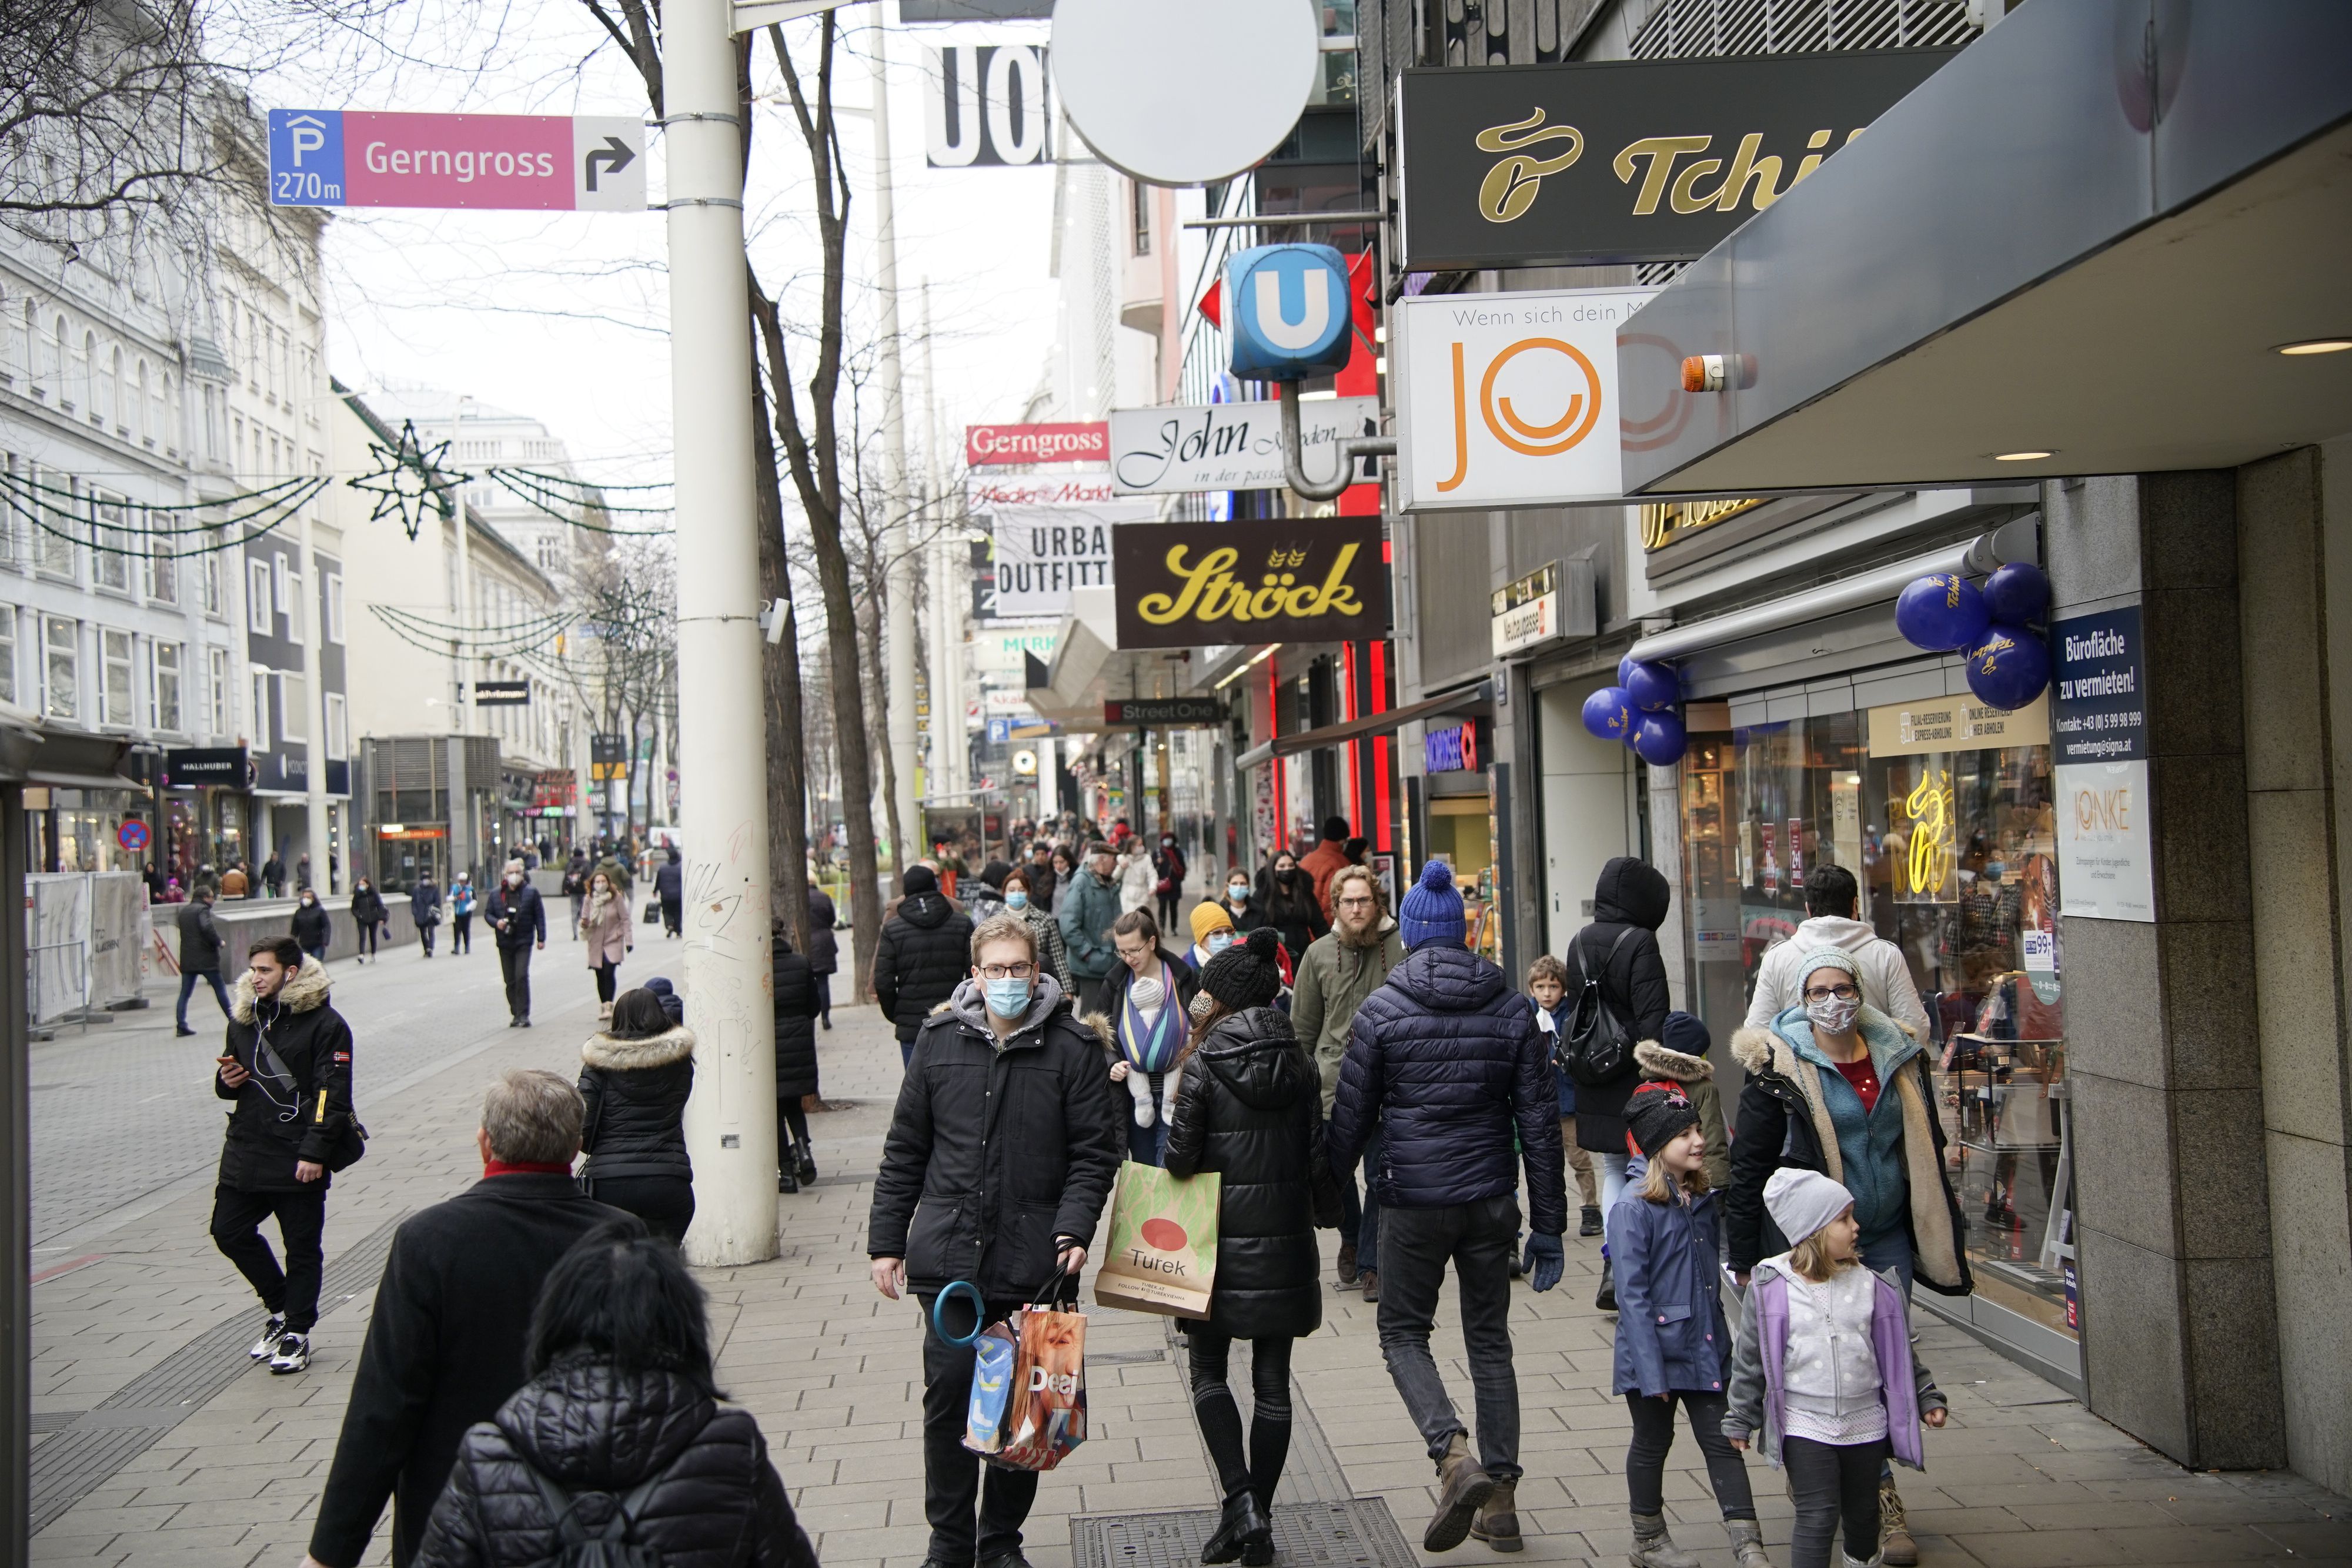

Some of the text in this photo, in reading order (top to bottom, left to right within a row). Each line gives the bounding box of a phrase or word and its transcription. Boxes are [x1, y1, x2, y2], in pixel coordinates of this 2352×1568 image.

[294, 128, 325, 167] P
[366, 141, 554, 183] Gerngross
[1613, 128, 1866, 215] Tchi
[1255, 269, 1329, 349] U
[1453, 309, 1514, 326] Wenn
[1525, 306, 1562, 323] sich
[1573, 305, 1616, 322] dein
[971, 428, 1103, 454] Gerngross
[1117, 411, 1248, 488] John
[971, 482, 1113, 504] Media Markt
[1031, 526, 1106, 557] URBA
[1138, 542, 1362, 625] Ströck
[2066, 628, 2125, 662] Bürofläche
[2060, 666, 2134, 700] zu vermieten!
[1122, 703, 1214, 720] Street One
[1911, 711, 1952, 726] FILIAL-RESERVIERUNG
[1969, 707, 1983, 720] ONLINE
[2056, 711, 2142, 733] Kontakt: +43 (0) 5 99 98 999
[1915, 726, 1952, 741] EXPRESS-ABHOLUNG
[1973, 723, 1983, 734] HIER
[1984, 721, 2004, 734] ABHOLEN!
[2067, 738, 2132, 757] vermietung@signa.at
[183, 763, 232, 771] HALLHUBER
[1131, 1248, 1186, 1276] Turek
[1141, 1282, 1165, 1291] TUREK.AT
[1151, 1290, 1185, 1300] TUREKVIENNA
